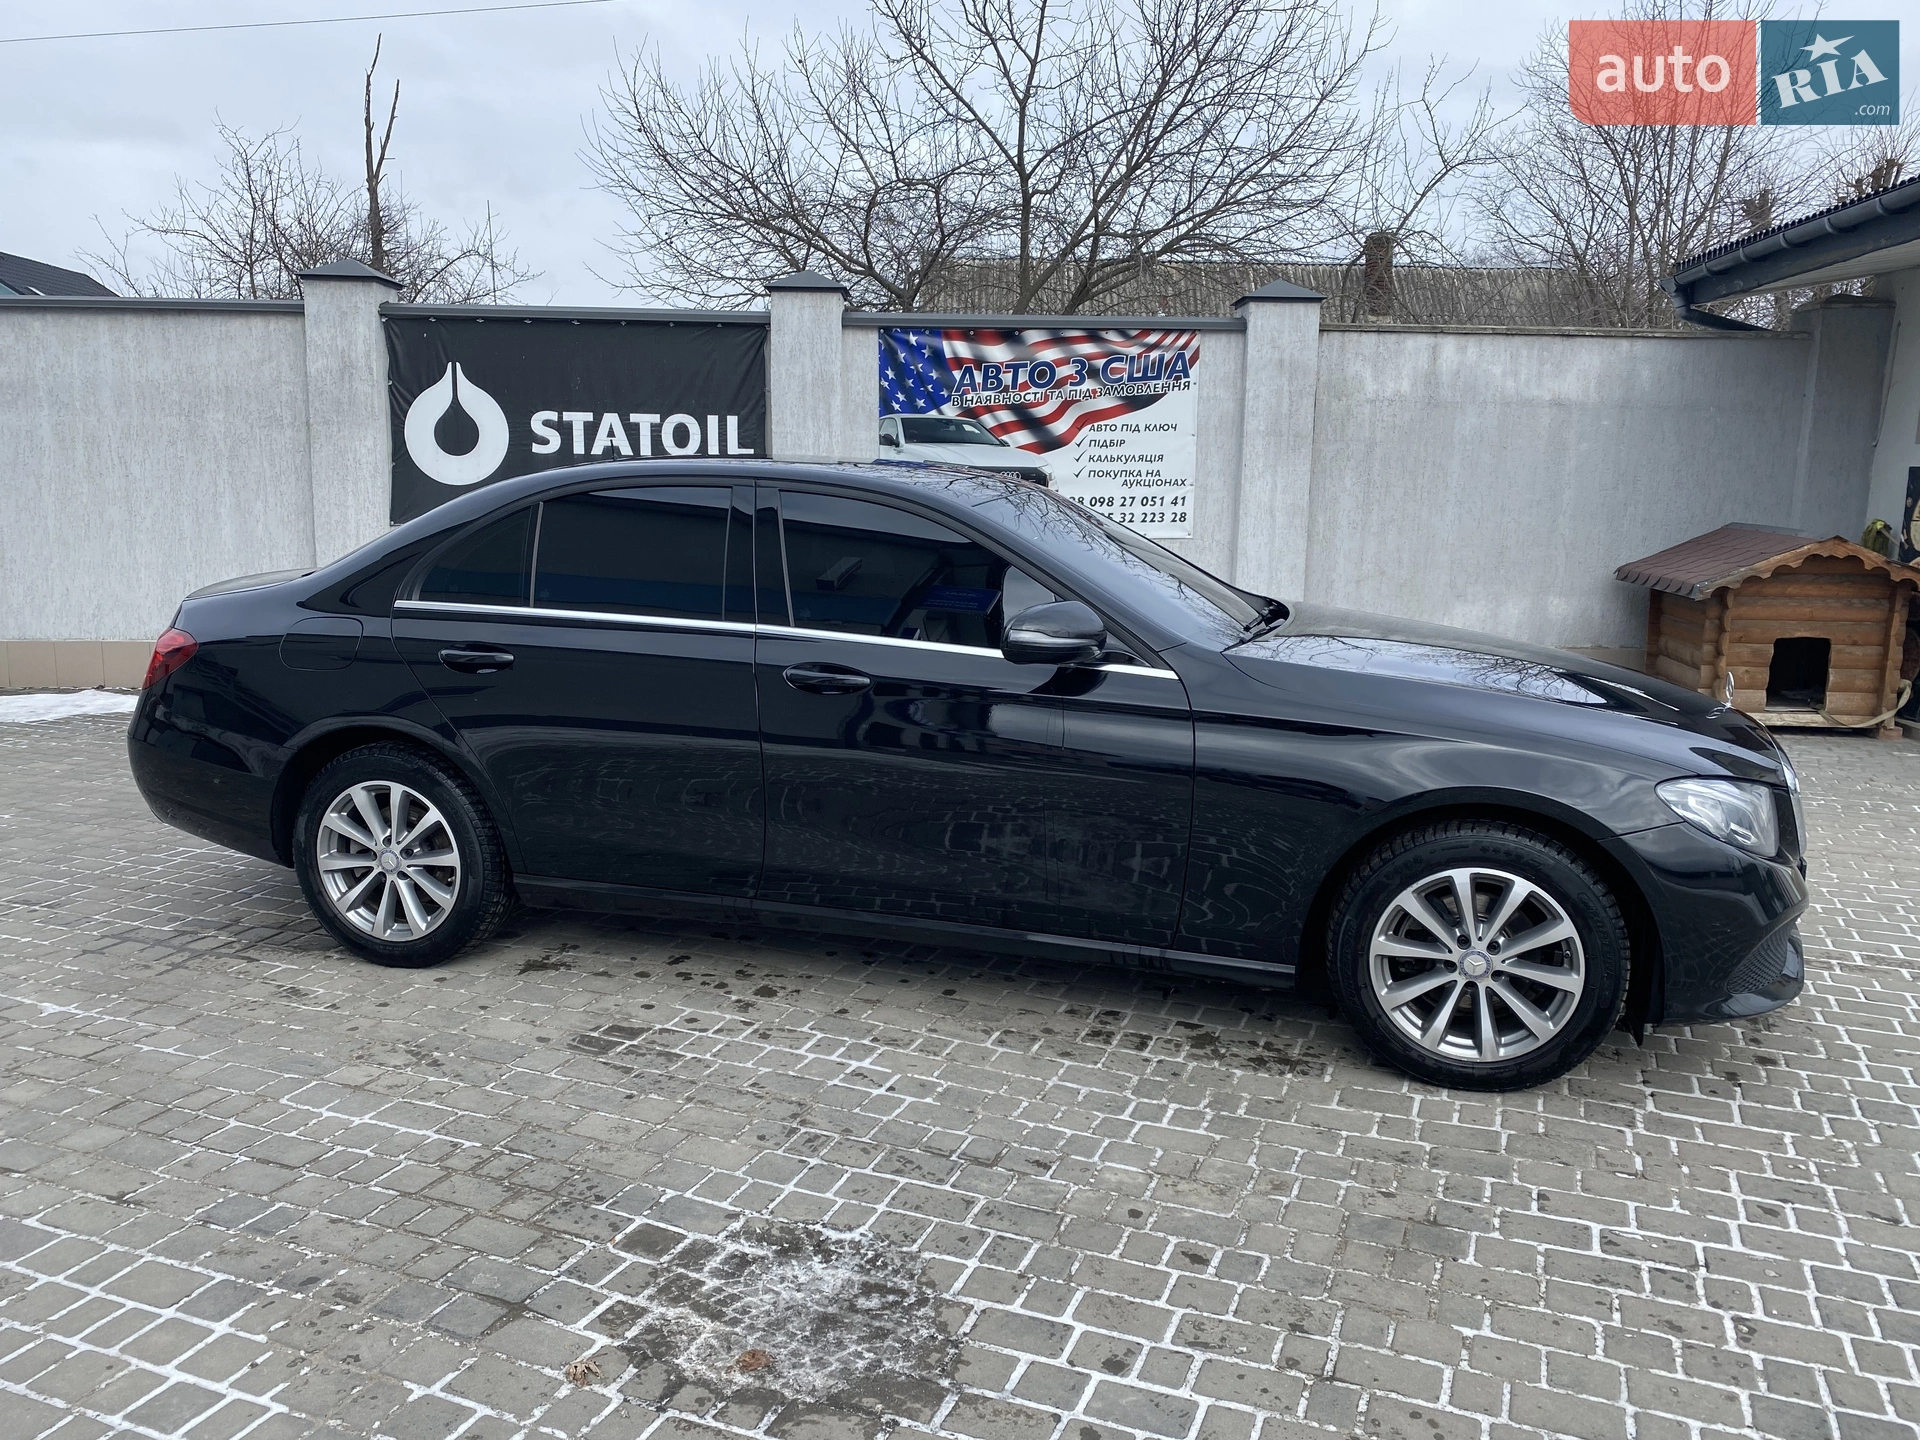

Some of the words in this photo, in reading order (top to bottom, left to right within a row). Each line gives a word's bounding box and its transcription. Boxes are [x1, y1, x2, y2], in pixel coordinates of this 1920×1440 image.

[952, 360, 1057, 394] АВТО
[1100, 351, 1191, 385] США
[951, 395, 961, 407] В
[963, 391, 1044, 407] НАЯВНОСТІ
[1048, 389, 1064, 401] ТА
[1068, 388, 1093, 401] ПІД
[1096, 380, 1191, 398] ЗАМОВЛЕННЯ
[530, 410, 755, 456] STATOIL
[1088, 423, 1118, 433] АВТО
[1120, 423, 1141, 434] ПІД
[1143, 423, 1178, 433] КЛЮЧ
[1088, 439, 1126, 449] ПІДБІР
[1088, 454, 1164, 465] КАЛЬКУЛЯЦІЯ
[1087, 469, 1143, 480] ПОКУПКА
[1145, 469, 1161, 478] НА
[1121, 478, 1188, 489] АУКЦІОНАХ
[1089, 496, 1115, 507] 098
[1119, 496, 1137, 507] 27
[1140, 496, 1165, 507] 051
[1170, 496, 1187, 507] 41
[1118, 512, 1135, 523] 32
[1140, 512, 1165, 523] 223
[1170, 511, 1187, 523] 28
